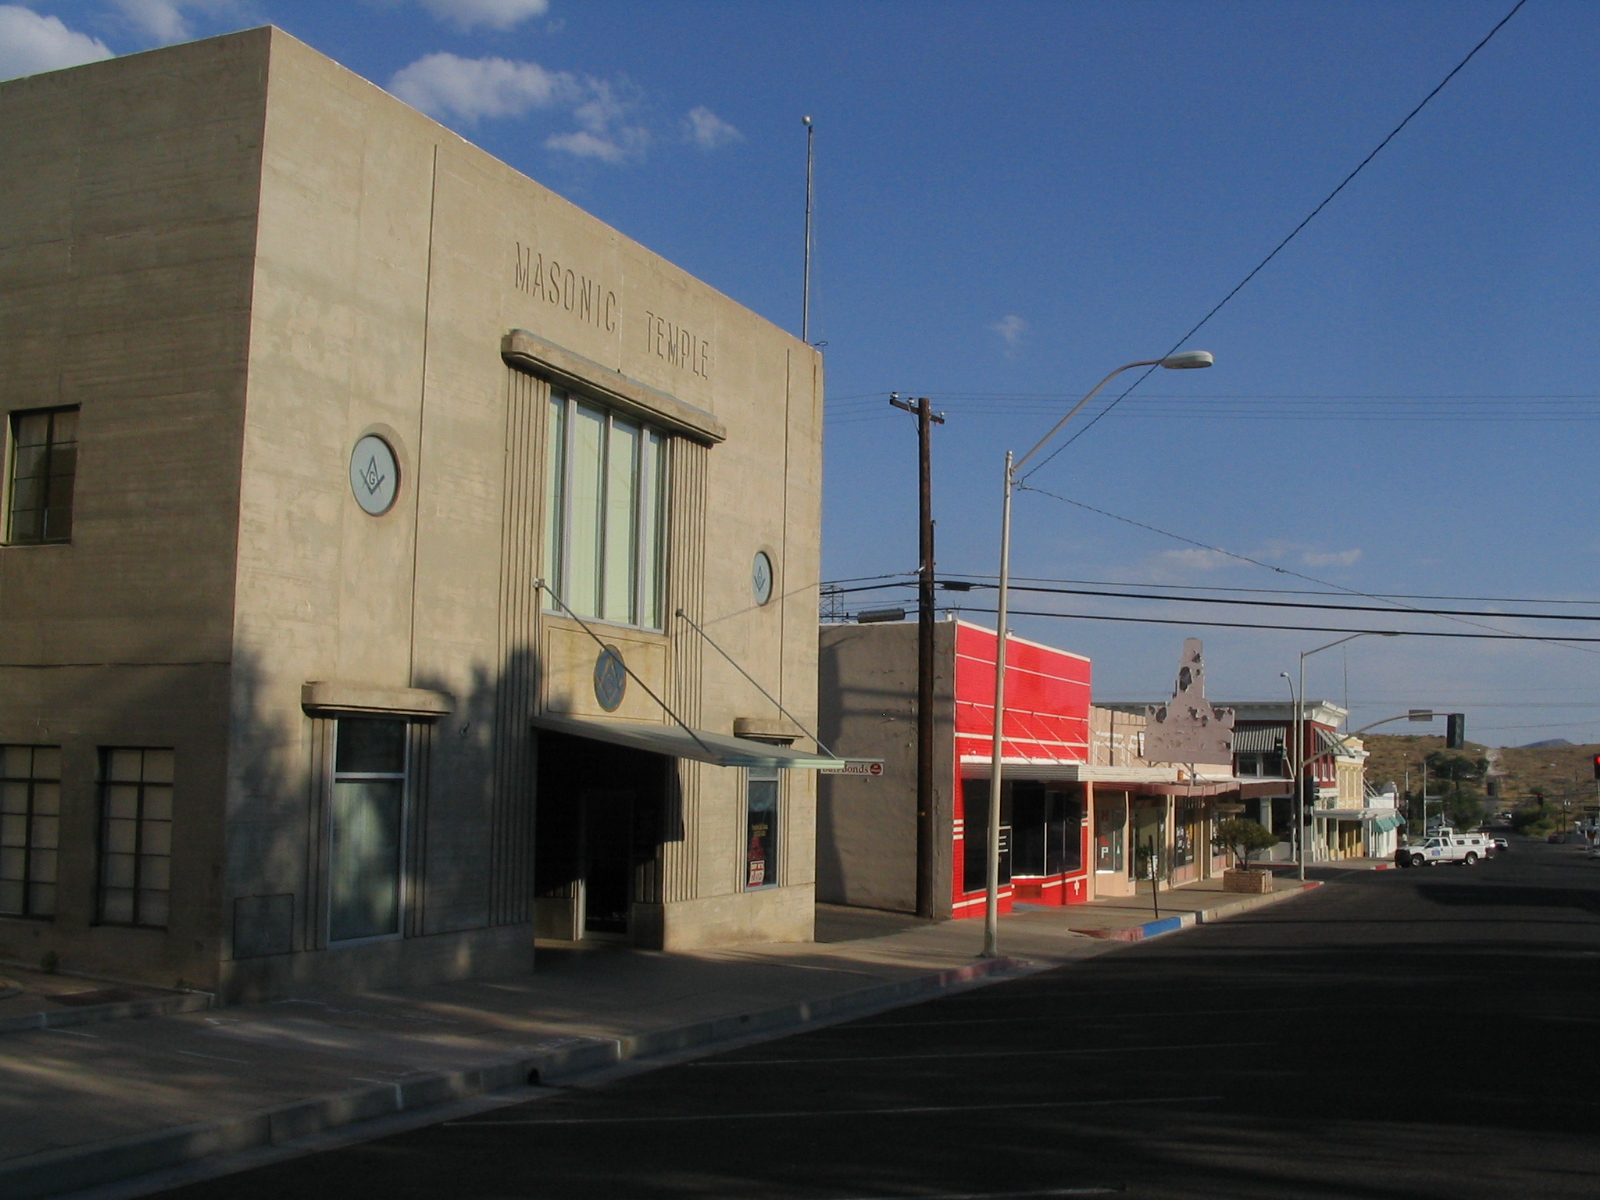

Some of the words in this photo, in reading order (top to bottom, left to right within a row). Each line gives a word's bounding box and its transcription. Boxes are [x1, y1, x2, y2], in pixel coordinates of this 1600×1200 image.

[515, 241, 616, 334] MASONIC
[645, 310, 709, 380] TEMPLE
[369, 471, 376, 485] G
